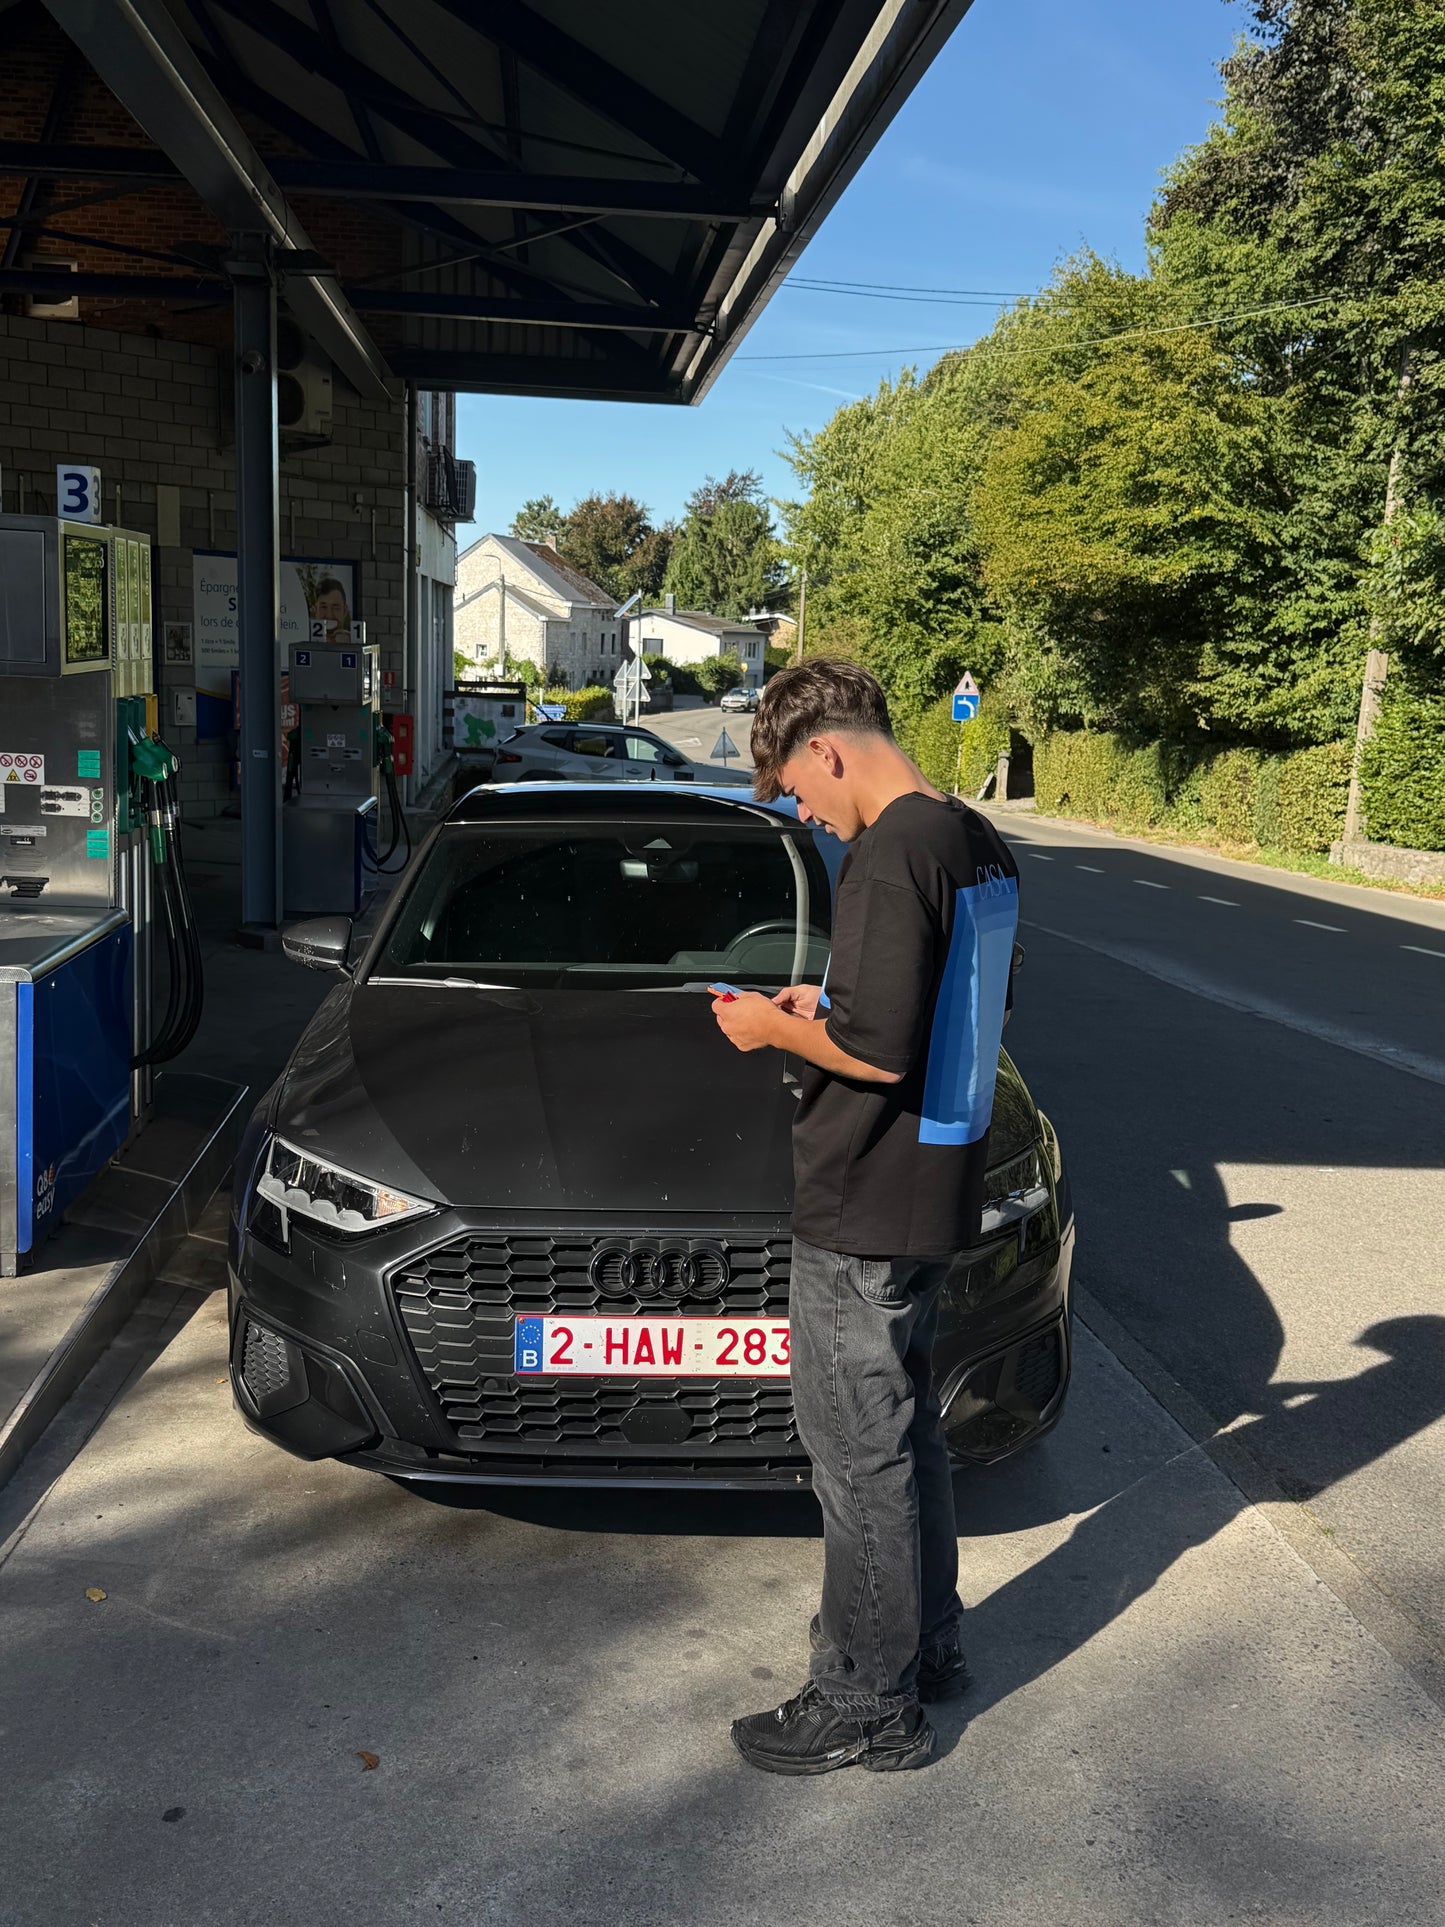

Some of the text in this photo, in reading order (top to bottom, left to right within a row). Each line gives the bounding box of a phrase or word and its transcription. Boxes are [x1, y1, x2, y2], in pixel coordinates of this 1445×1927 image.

[63, 473, 89, 513] 3
[93, 475, 100, 515] 3
[200, 615, 218, 627] lors
[220, 615, 234, 628] de
[280, 614, 300, 630] lein.
[313, 622, 323, 637] 2
[353, 624, 361, 638] 1
[299, 654, 307, 664] 2
[346, 656, 352, 667] 1
[975, 863, 1011, 900] CASA
[36, 1169, 48, 1197] Q8
[36, 1186, 56, 1221] easy
[549, 1326, 791, 1366] 2-HAW-283
[522, 1349, 539, 1367] B
